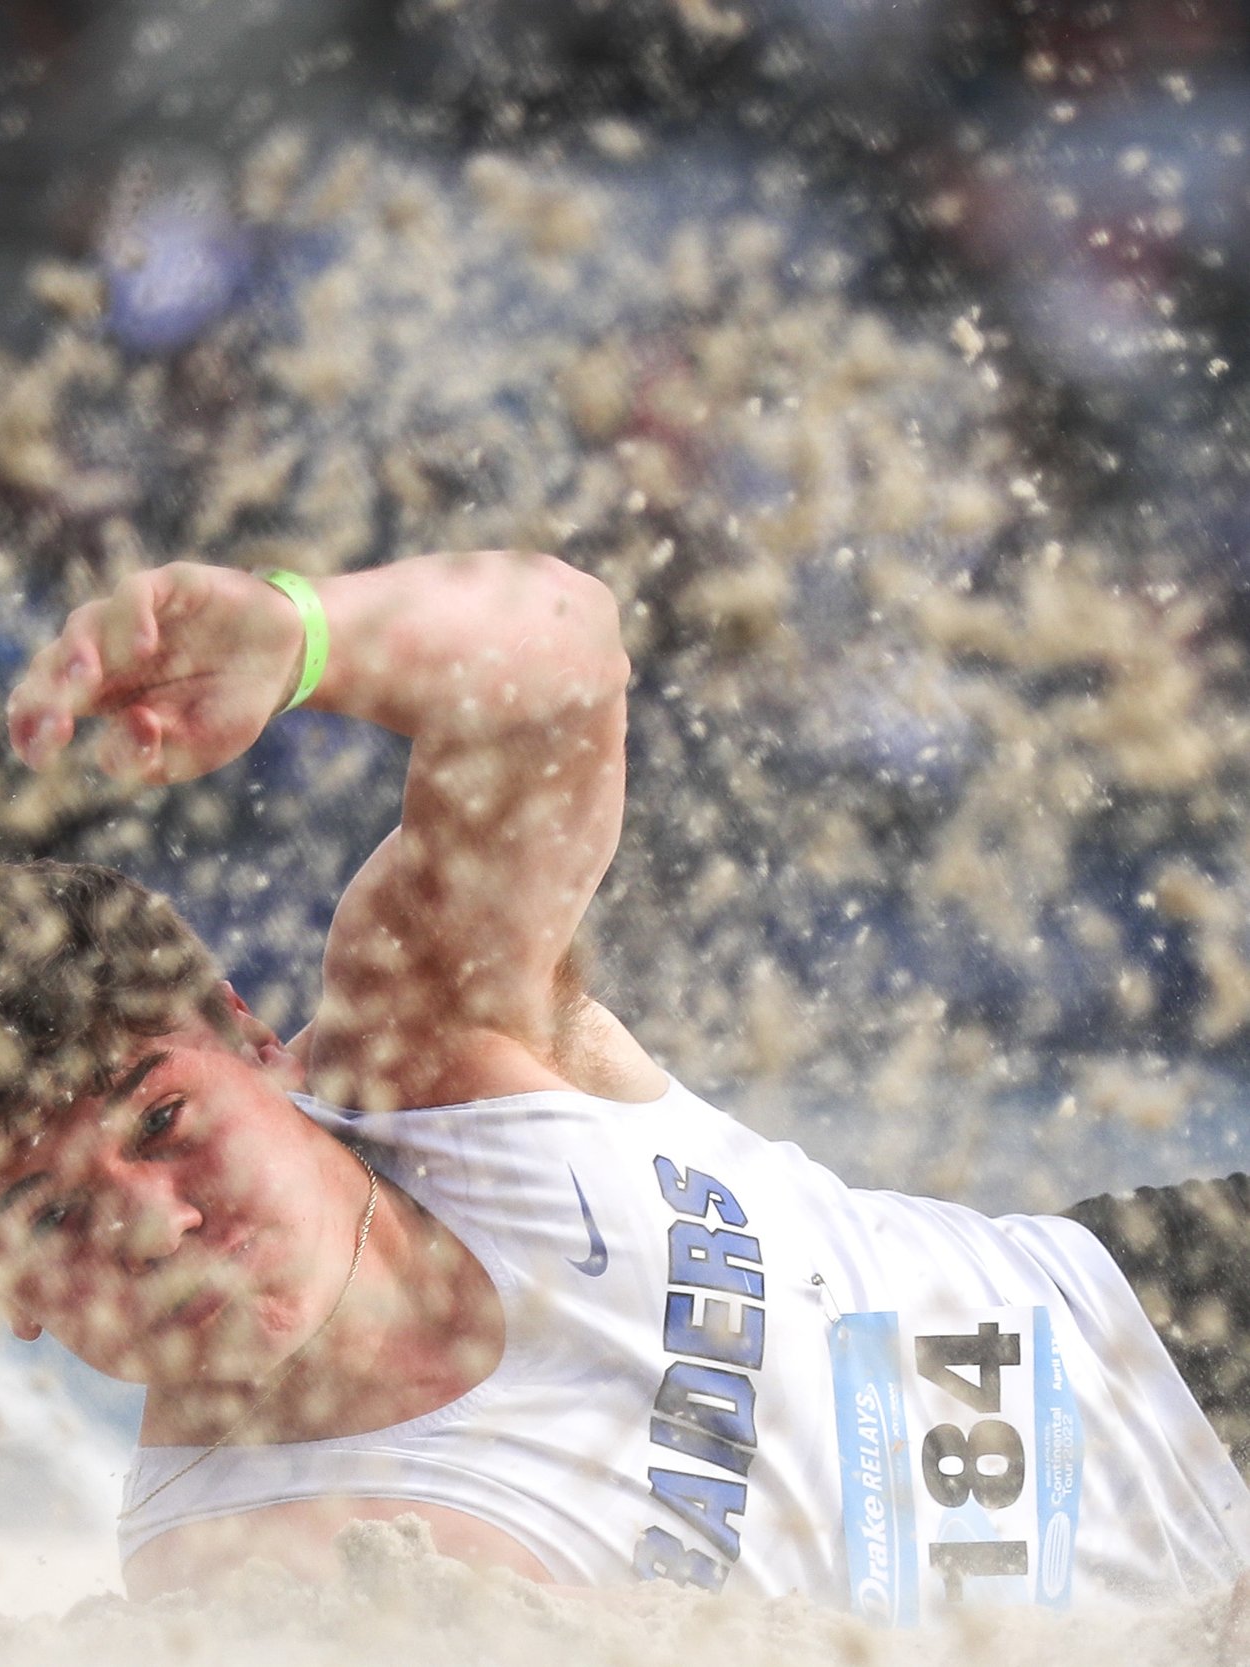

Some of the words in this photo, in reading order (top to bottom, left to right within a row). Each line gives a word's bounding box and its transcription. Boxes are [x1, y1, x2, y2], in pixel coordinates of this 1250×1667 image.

[631, 1154, 766, 1595] RAIDERS
[1052, 1358, 1063, 1391] April
[854, 1391, 884, 1492] RELAYS
[914, 1322, 1029, 1602] 184
[1050, 1407, 1063, 1505] Continental
[1062, 1413, 1074, 1461] 2022
[1062, 1462, 1074, 1496] Tour
[857, 1495, 891, 1622] Drake
